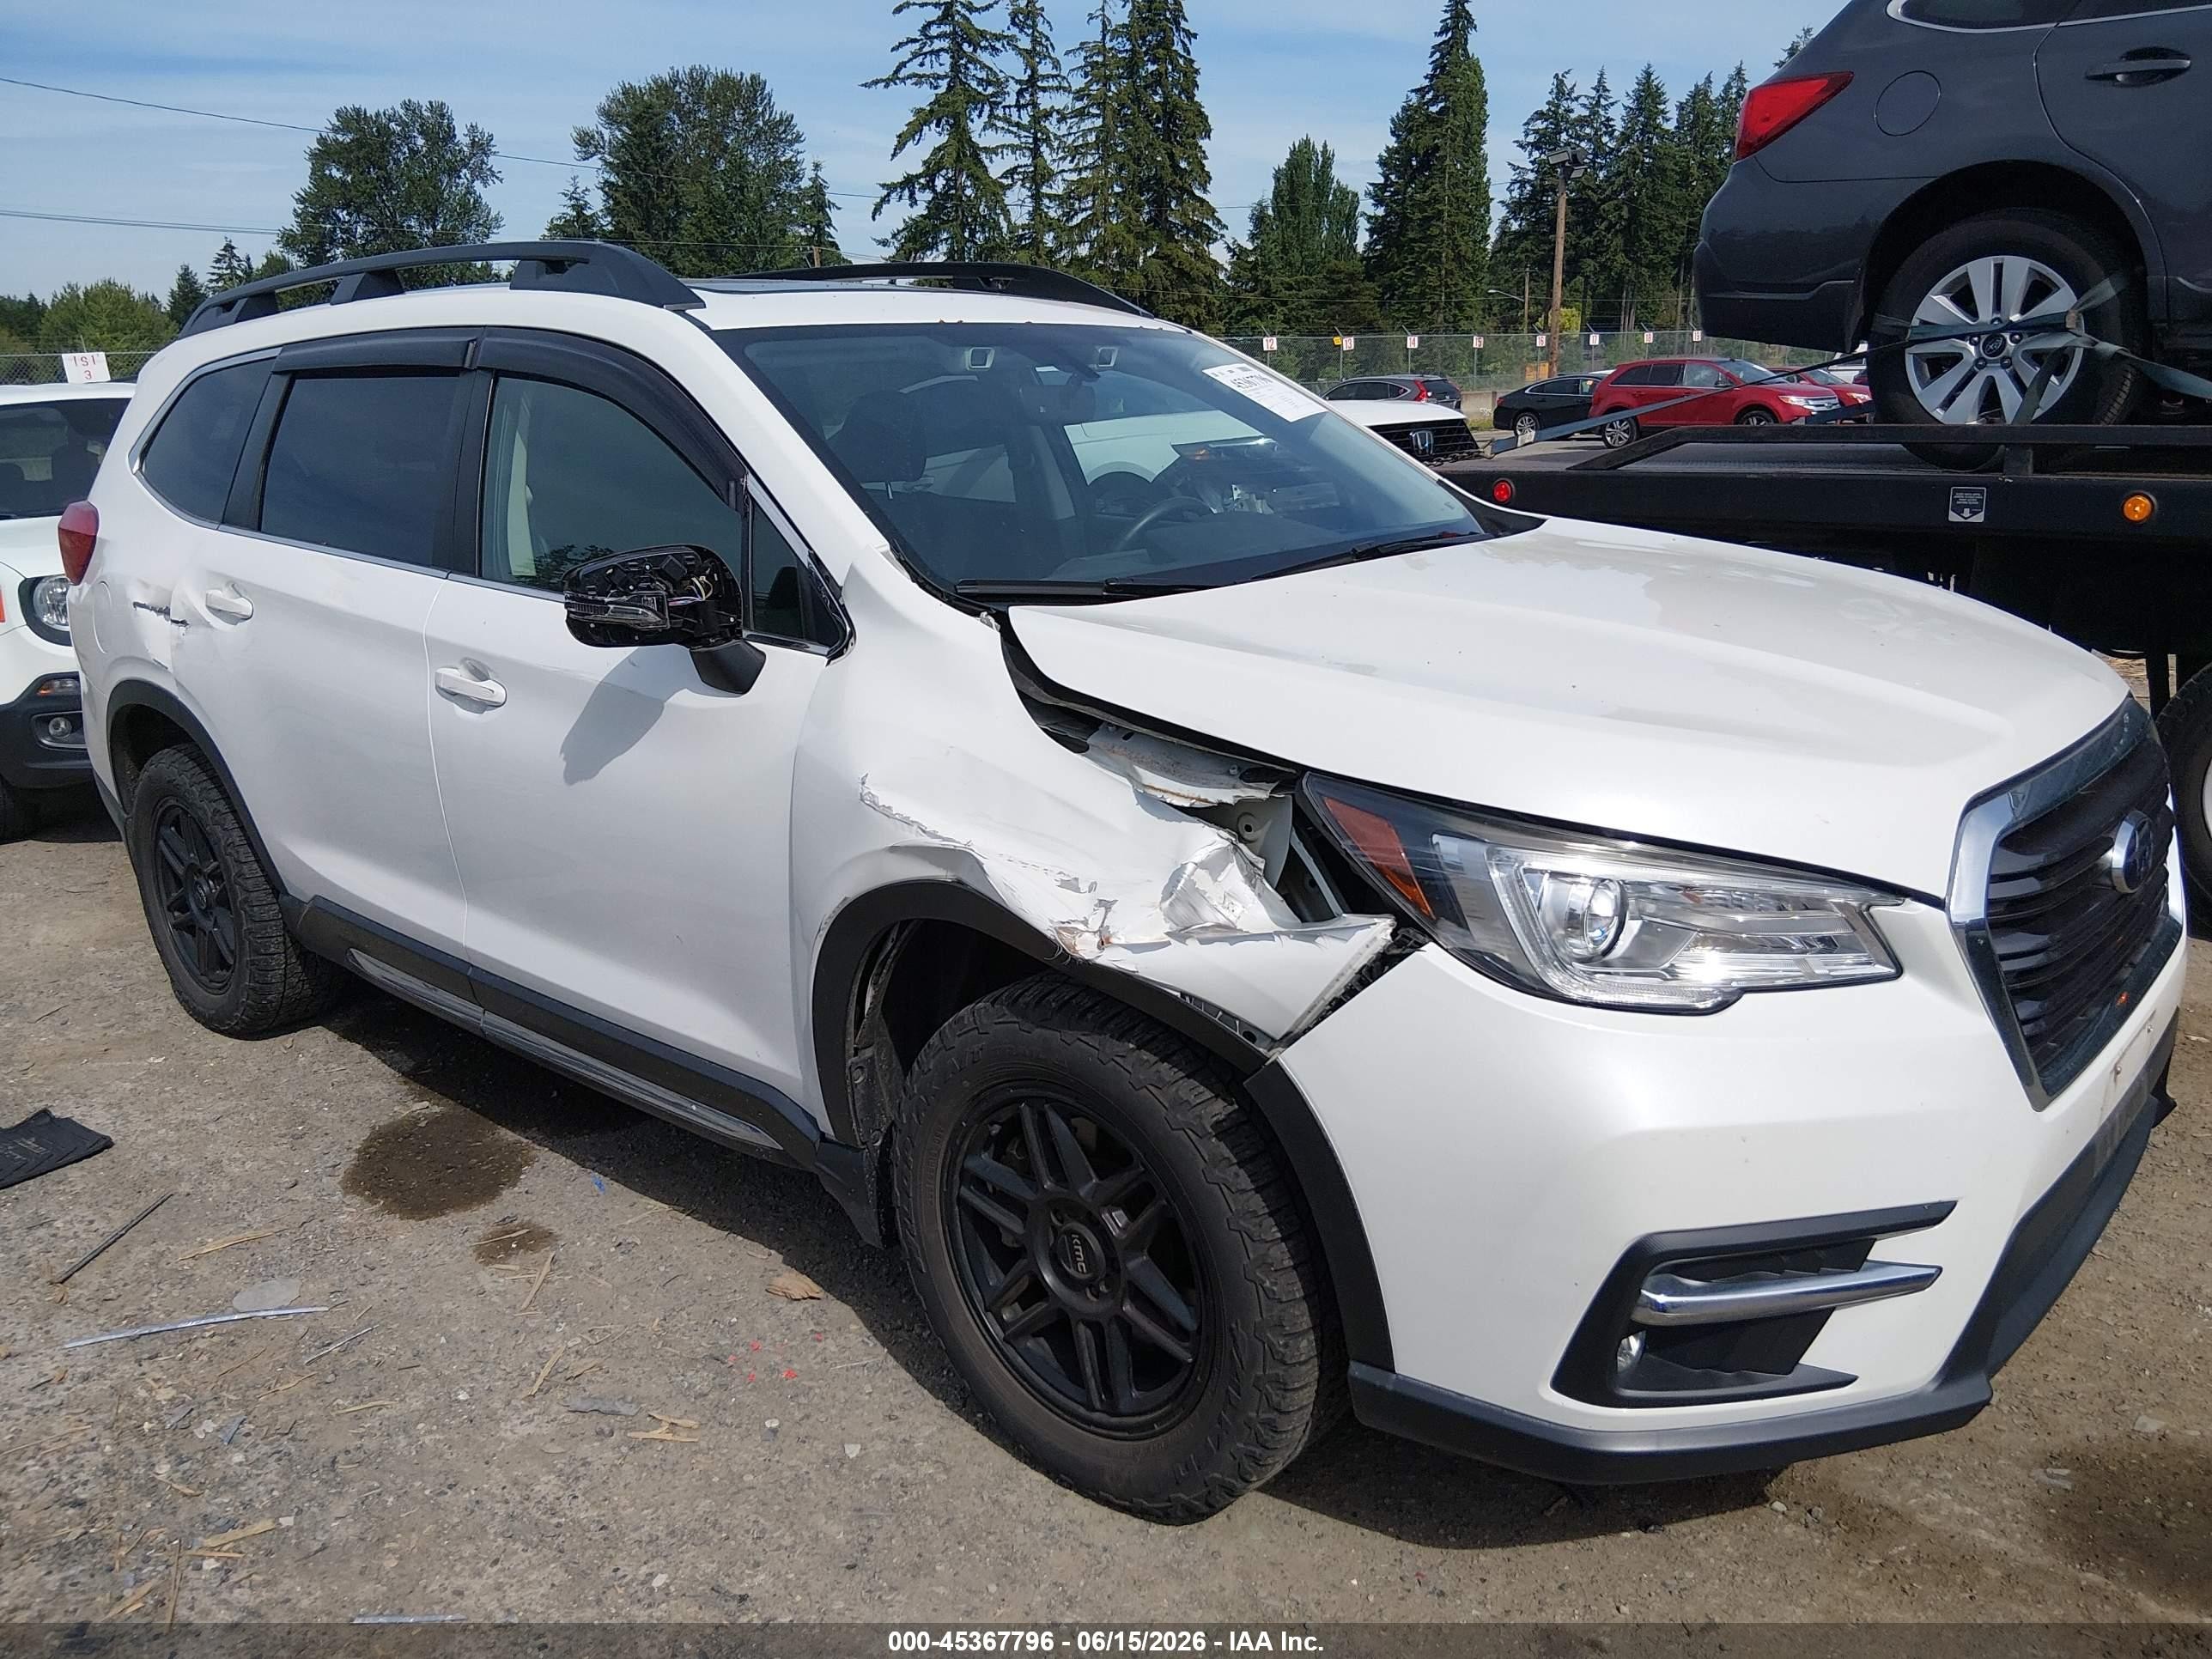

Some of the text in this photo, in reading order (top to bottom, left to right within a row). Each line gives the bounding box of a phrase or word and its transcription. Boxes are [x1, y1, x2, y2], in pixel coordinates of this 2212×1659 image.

[1265, 338, 1274, 349] 12
[1345, 338, 1353, 349] 13
[1408, 337, 1416, 347] 14
